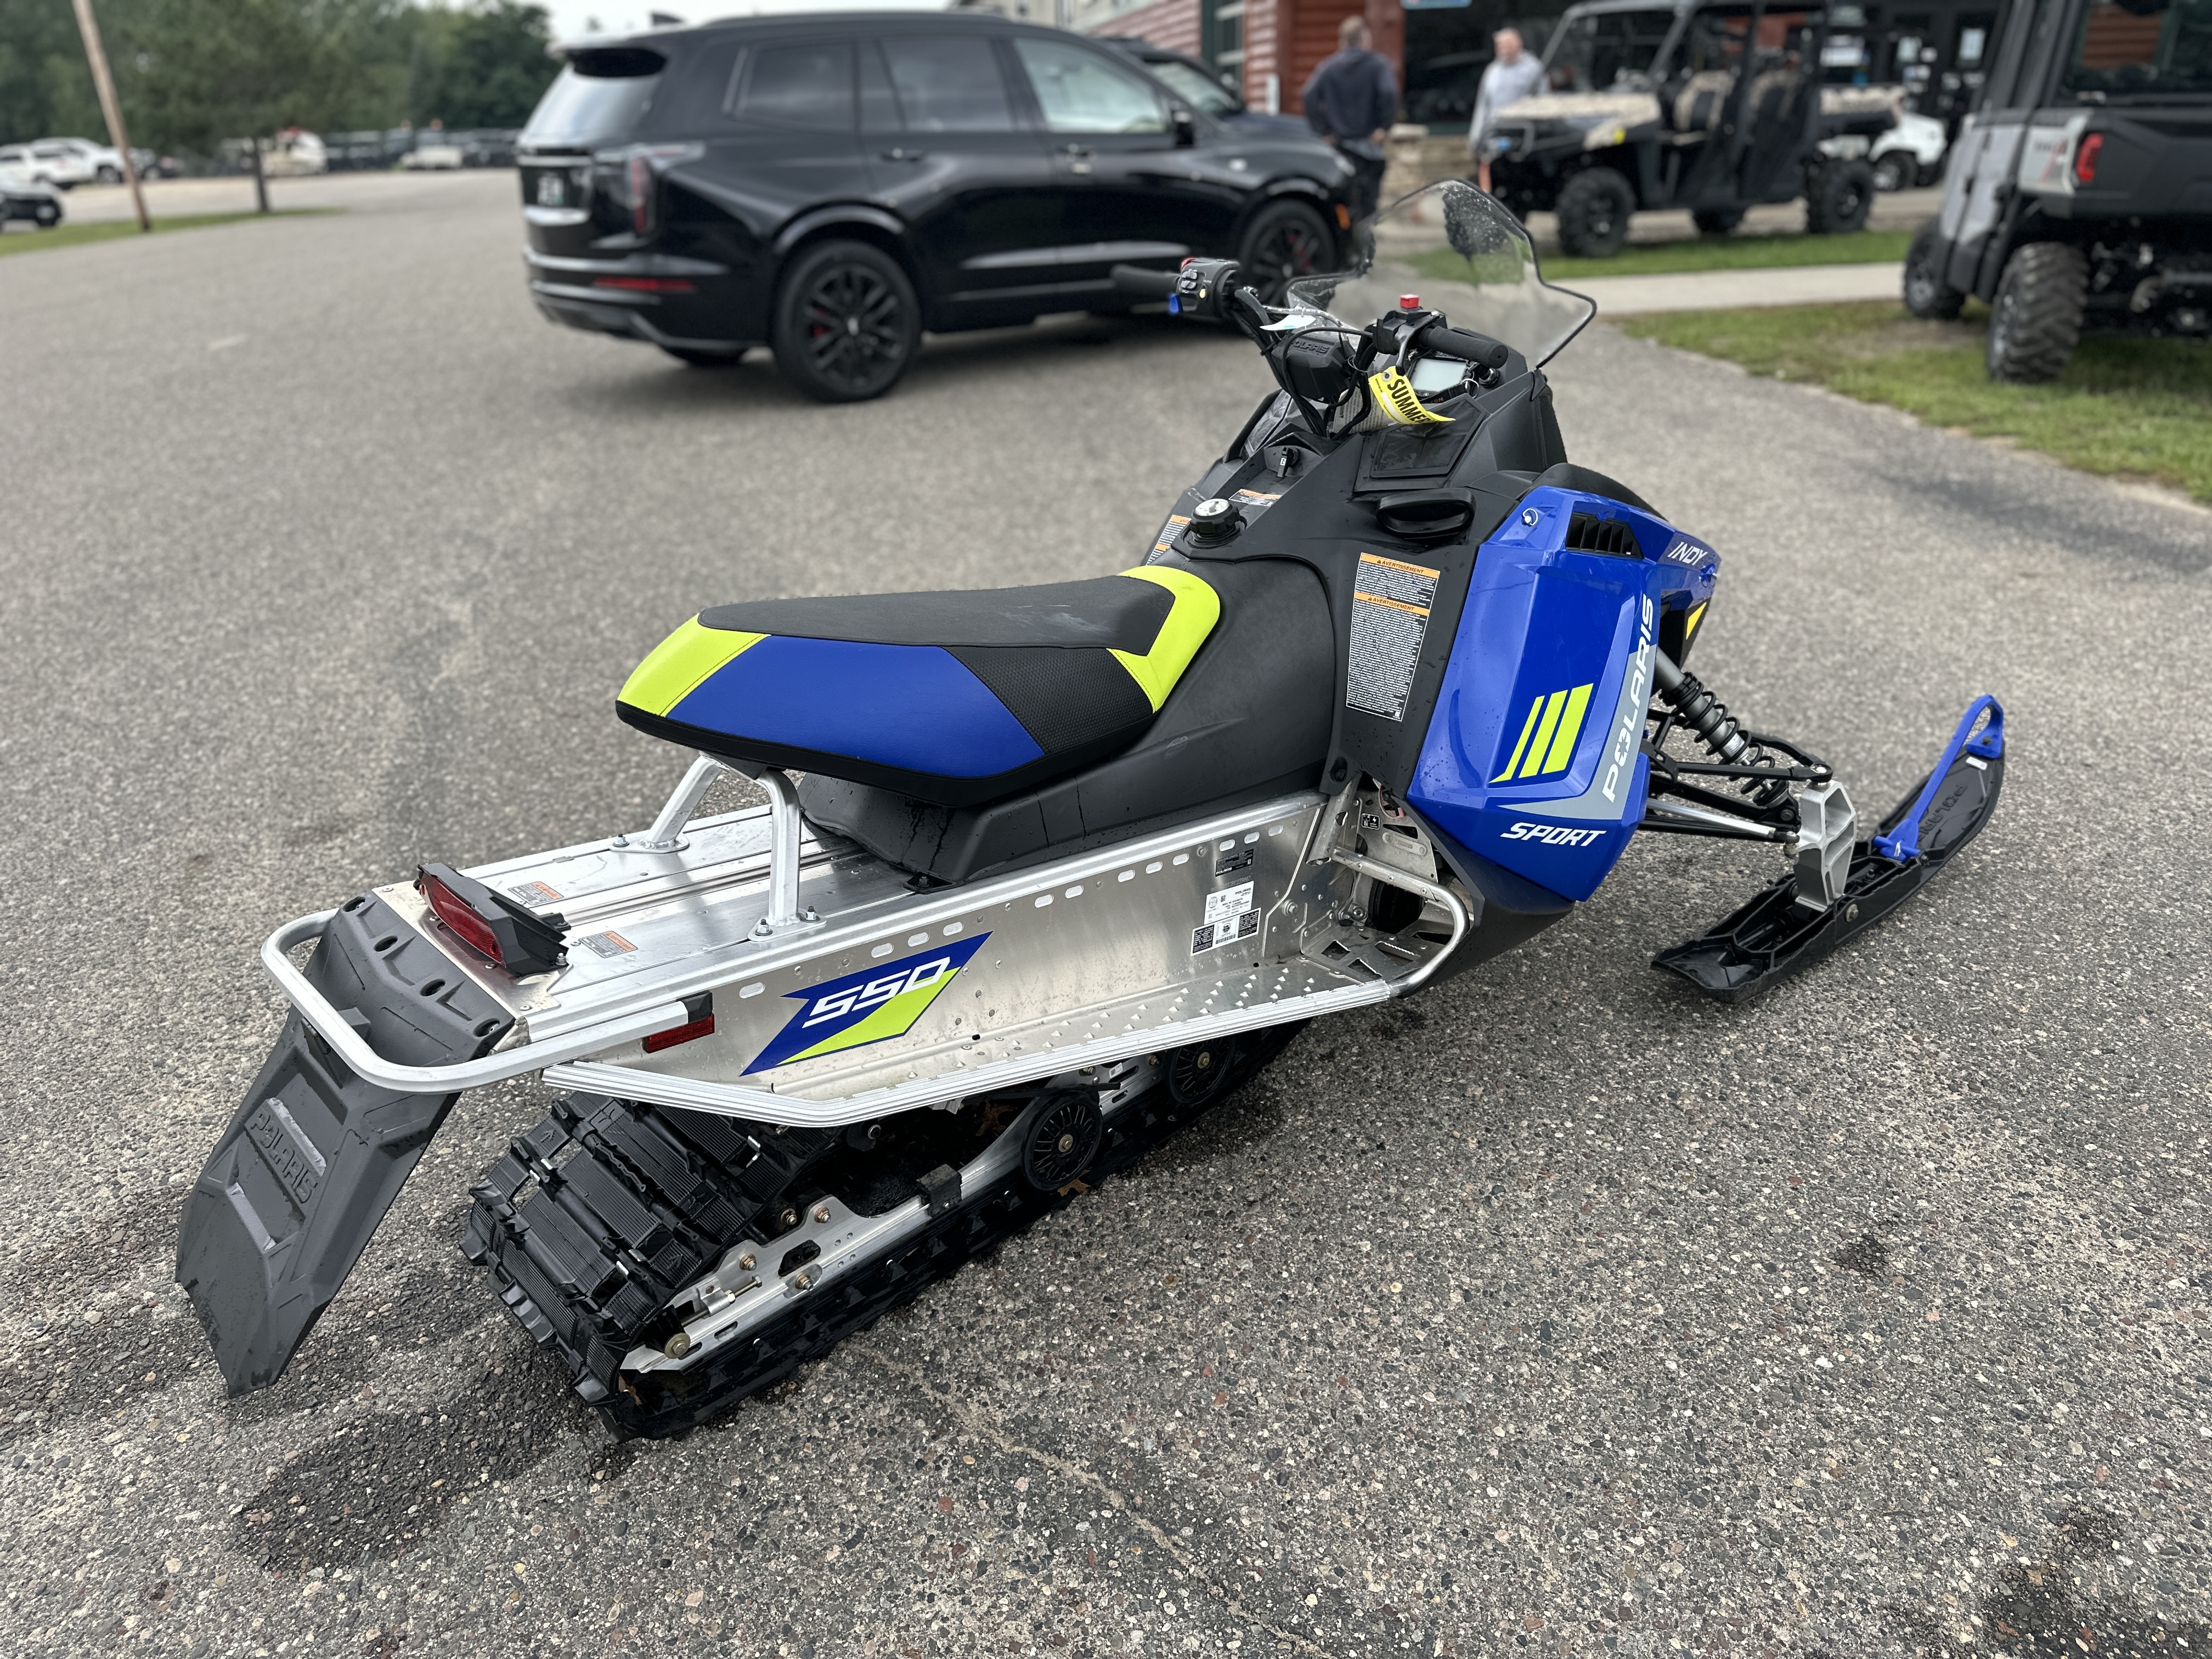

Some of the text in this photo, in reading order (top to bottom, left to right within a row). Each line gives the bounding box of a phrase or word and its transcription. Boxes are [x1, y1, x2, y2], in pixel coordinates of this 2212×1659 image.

[1291, 340, 1330, 354] OLARIS
[1667, 541, 1708, 566] INDY
[1382, 560, 1424, 574] AVERTISSEMENT
[1372, 596, 1415, 611] AVERTISSEMENT
[1602, 594, 1654, 803] POLARIS
[1500, 822, 1607, 847] SPORT
[802, 957, 950, 1029] 550
[250, 1109, 319, 1204] POLARIS
